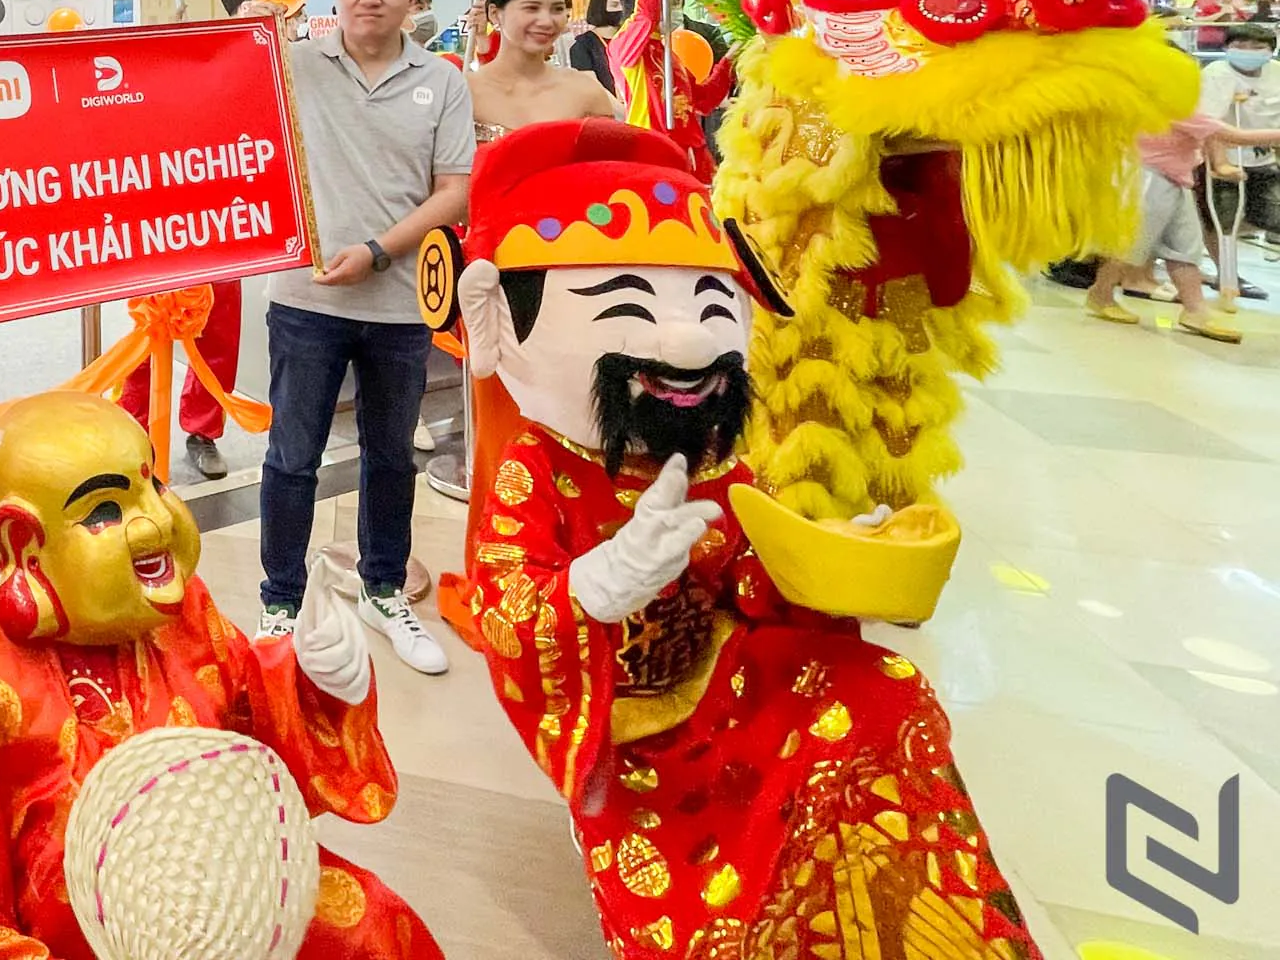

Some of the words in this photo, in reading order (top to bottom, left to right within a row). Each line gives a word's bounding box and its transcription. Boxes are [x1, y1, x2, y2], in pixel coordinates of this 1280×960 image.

[310, 16, 338, 29] GRAN
[81, 92, 144, 108] DIGIWORLD
[70, 153, 152, 200] KHAI
[158, 133, 276, 187] NGHIỆP
[48, 213, 133, 271] KHẢI
[140, 196, 273, 256] NGUYÊN
